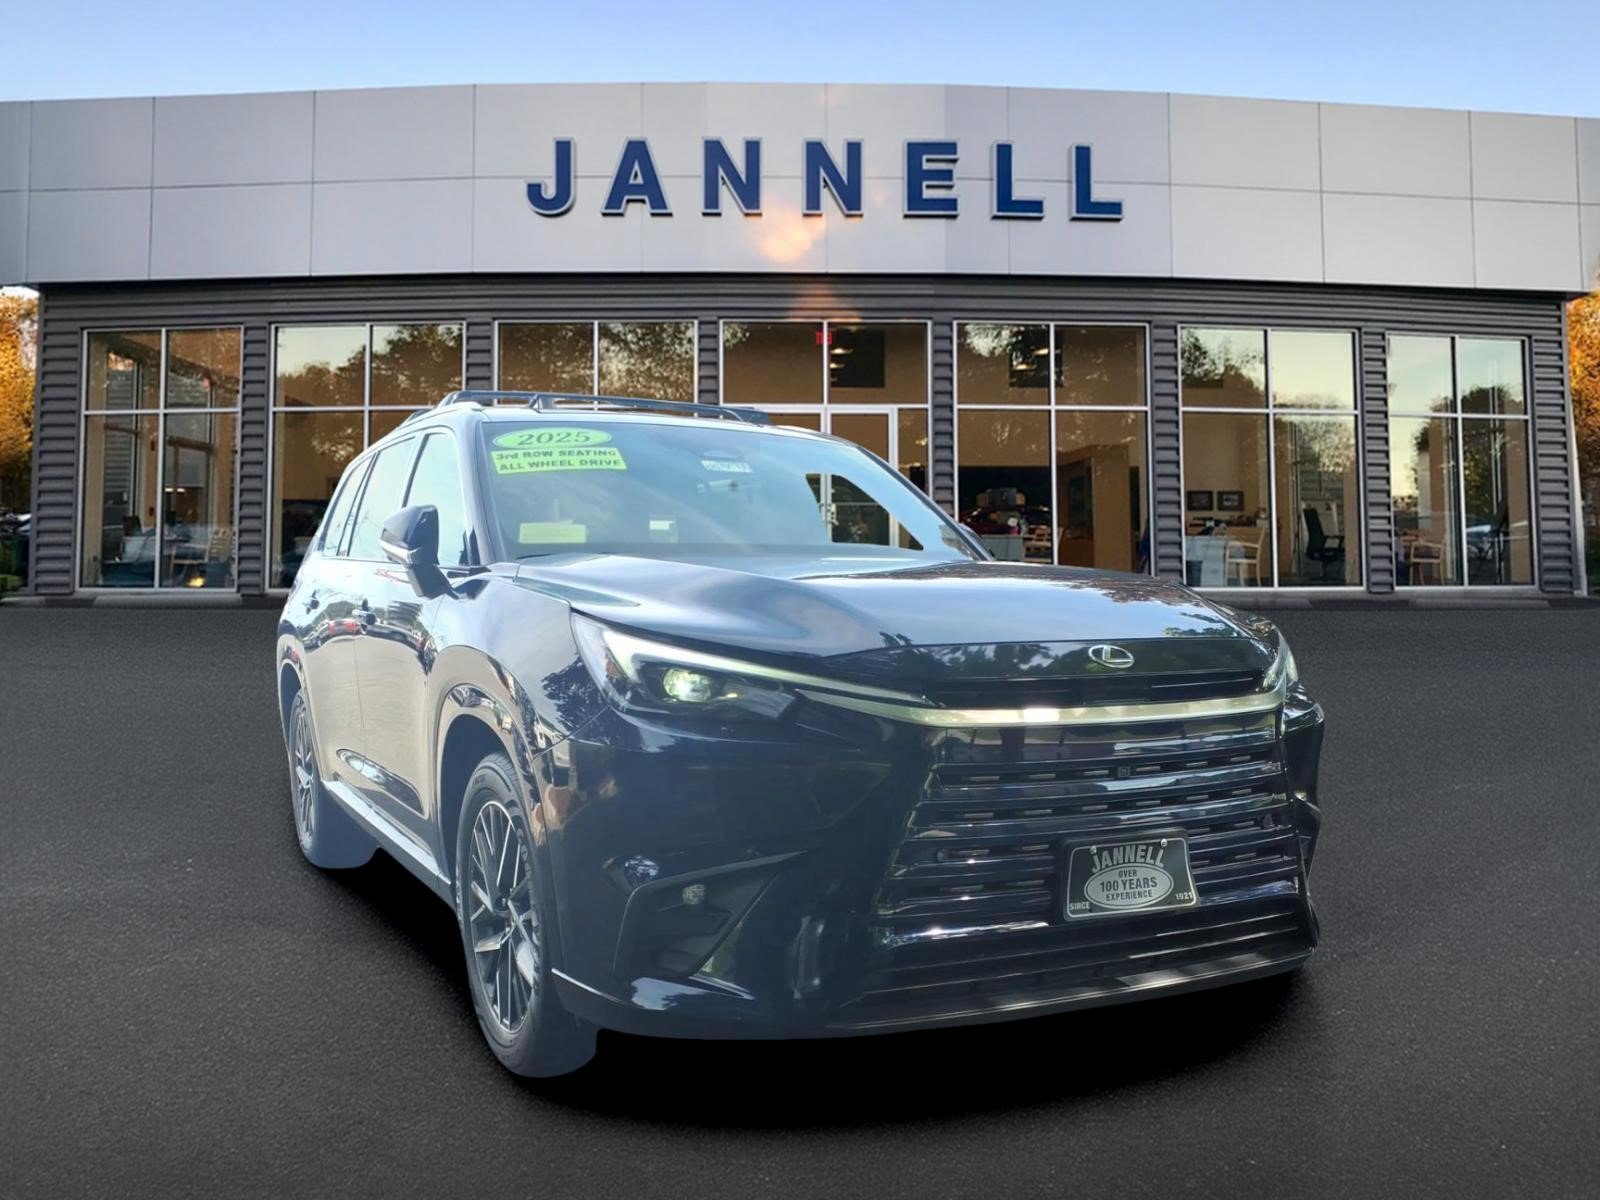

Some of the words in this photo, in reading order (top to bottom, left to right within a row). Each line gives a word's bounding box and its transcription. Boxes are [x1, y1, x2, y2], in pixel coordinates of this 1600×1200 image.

[525, 136, 1124, 219] JANNELL
[518, 431, 591, 446] 2025
[496, 450, 519, 461] 3rd
[523, 448, 554, 459] ROW
[558, 447, 617, 458] SEATING
[499, 461, 525, 472] ALL
[528, 458, 573, 469] WHEEL
[579, 457, 622, 467] DRIVE
[1091, 845, 1164, 874] JANNELL
[1118, 869, 1137, 879] OVER
[1099, 880, 1119, 893] 100
[1121, 876, 1157, 891] YEARS
[1106, 890, 1153, 902] EXPERIENCE
[1069, 901, 1090, 911] SINCE
